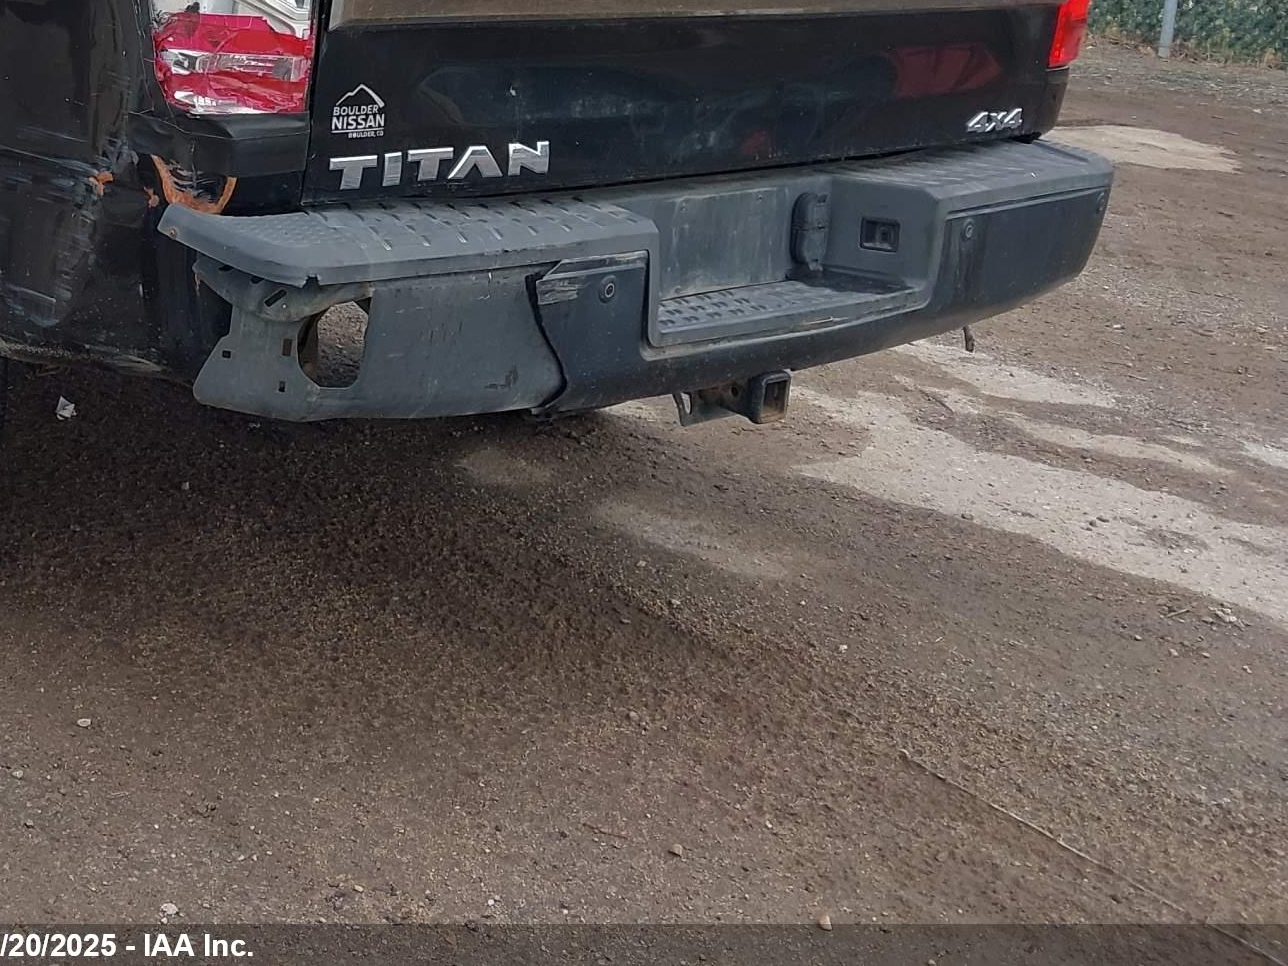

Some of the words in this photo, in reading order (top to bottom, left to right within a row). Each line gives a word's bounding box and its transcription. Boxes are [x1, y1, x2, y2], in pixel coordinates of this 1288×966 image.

[333, 105, 379, 116] BOULDER
[332, 114, 385, 130] NISSAN
[329, 141, 550, 190] TITAN
